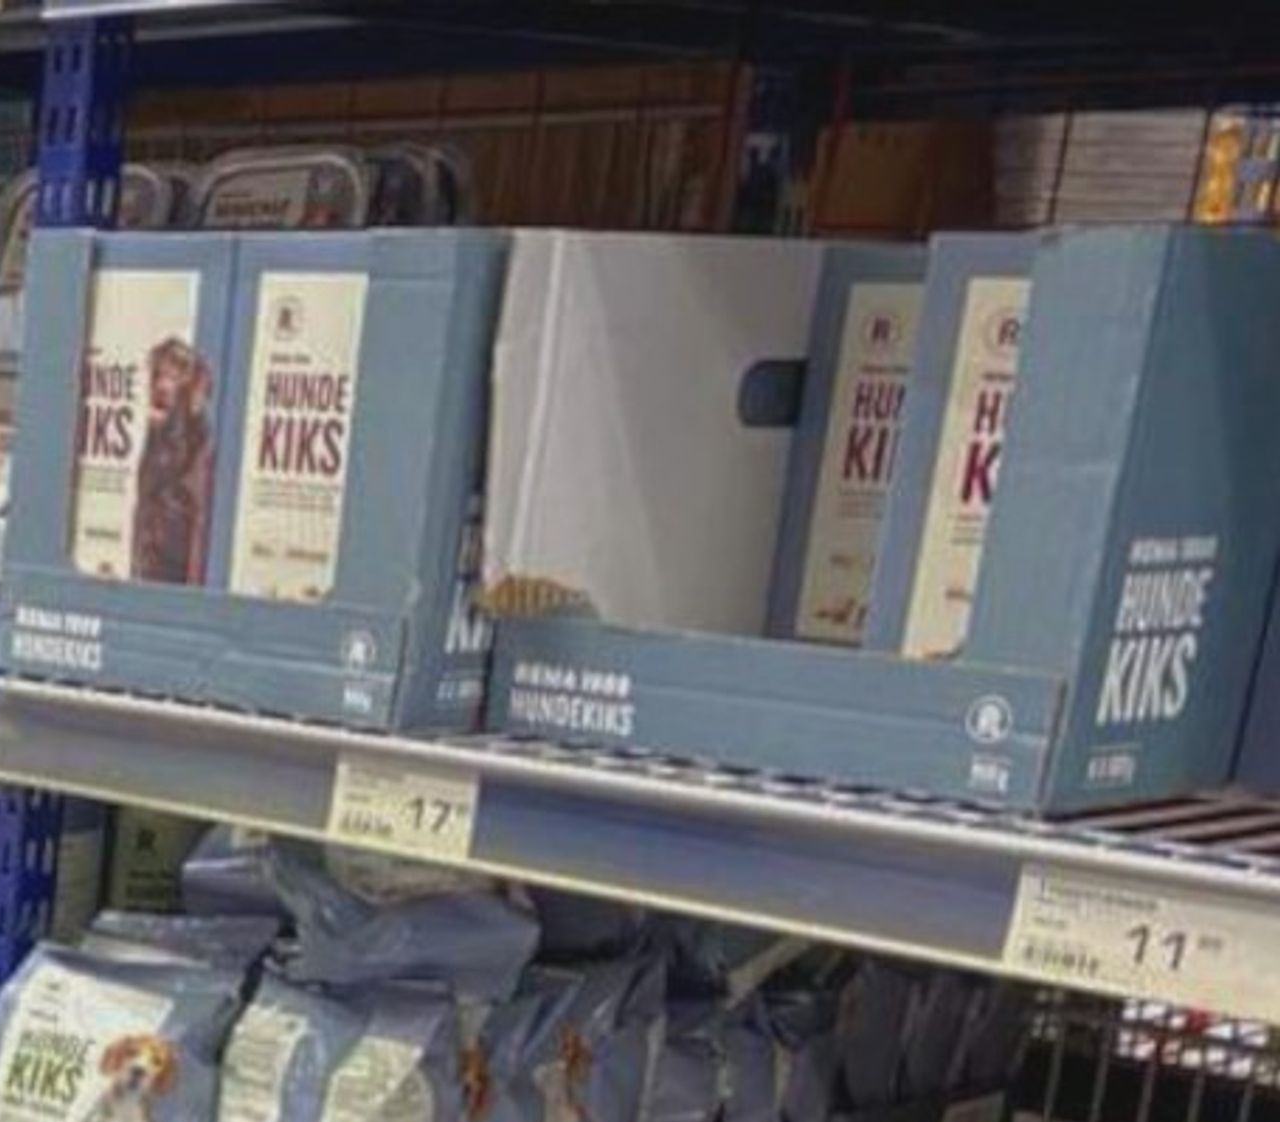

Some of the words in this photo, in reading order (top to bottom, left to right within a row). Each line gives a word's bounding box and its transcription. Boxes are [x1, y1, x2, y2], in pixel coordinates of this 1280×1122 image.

[264, 371, 349, 413] HUNDE
[258, 414, 345, 477] KIKS
[1116, 569, 1214, 632] HUNDE
[514, 662, 577, 691] REMA
[1096, 632, 1197, 727] KIKS
[509, 688, 635, 737] HUNDEKIKS
[5, 1052, 85, 1104] KIKS
